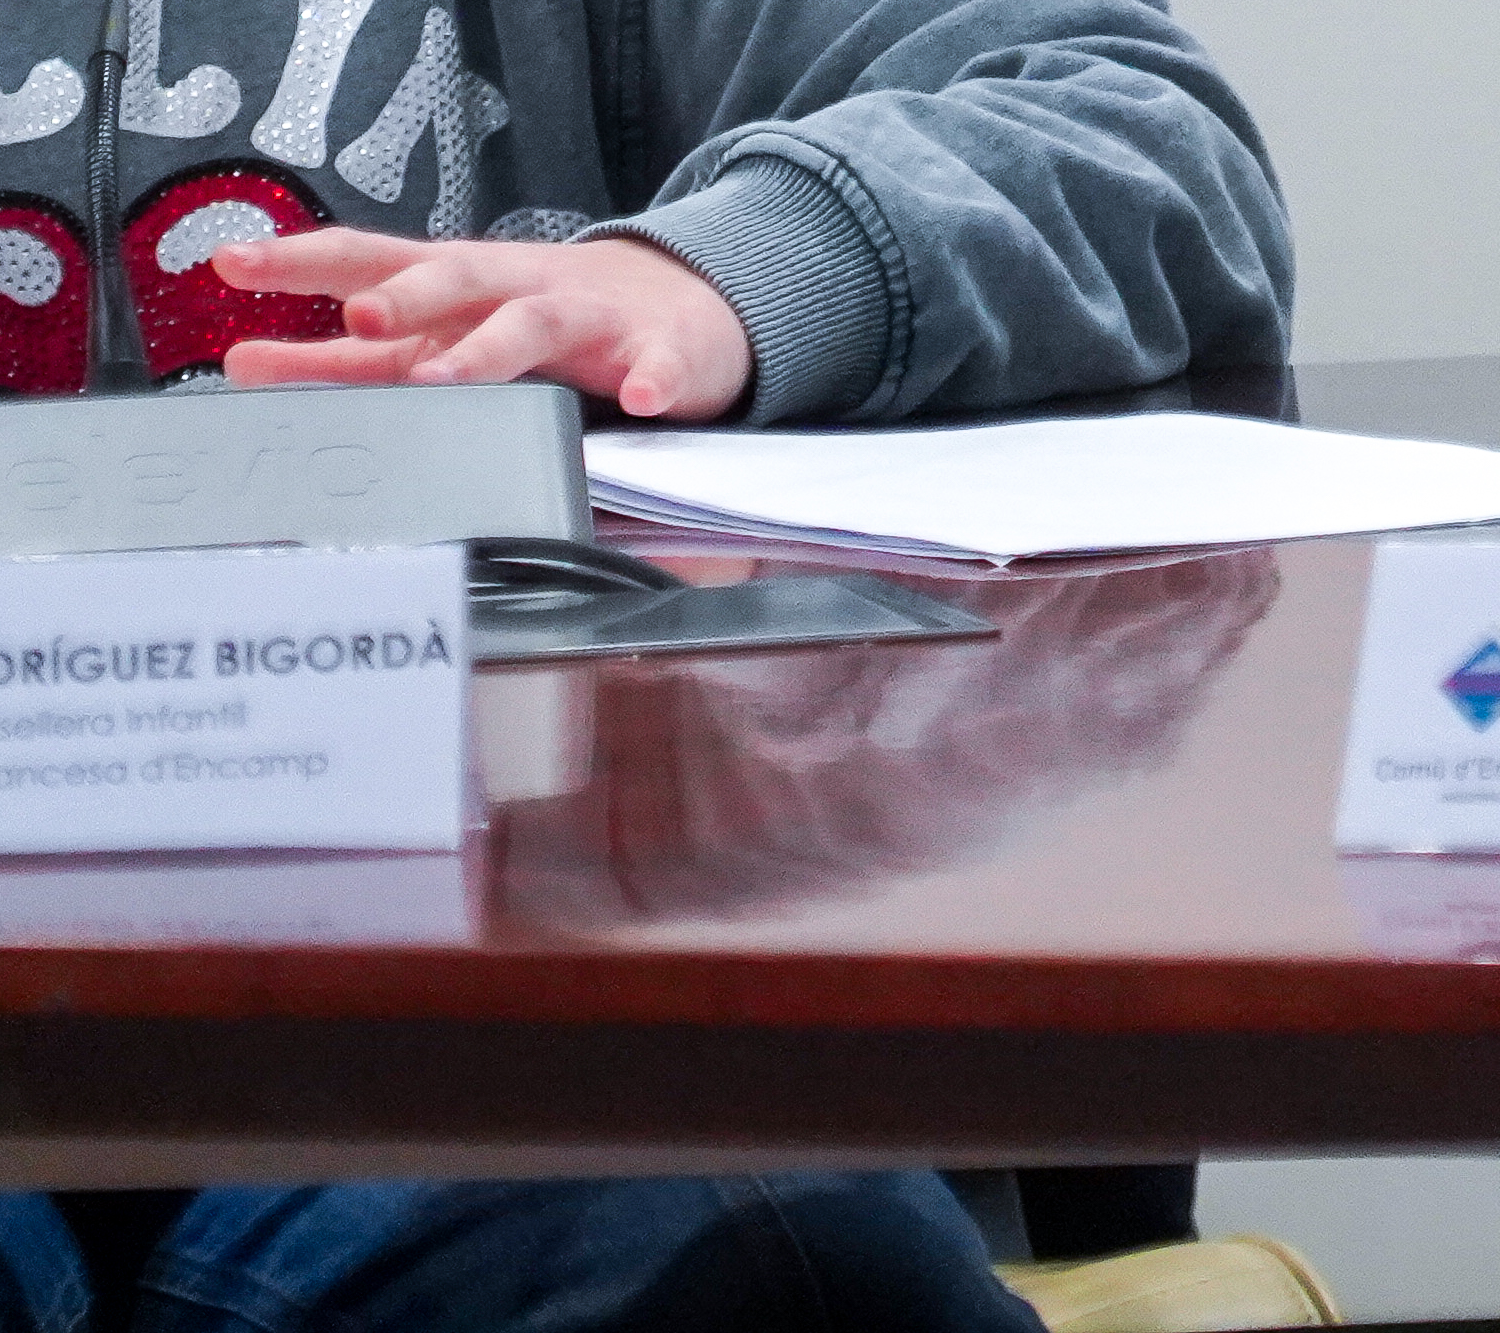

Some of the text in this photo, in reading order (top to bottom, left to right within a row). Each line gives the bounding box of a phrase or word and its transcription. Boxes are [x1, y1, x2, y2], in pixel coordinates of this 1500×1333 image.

[214, 617, 453, 676] BIGORDÀ
[126, 700, 246, 735] Infantil
[140, 751, 329, 785] d'Encamp
